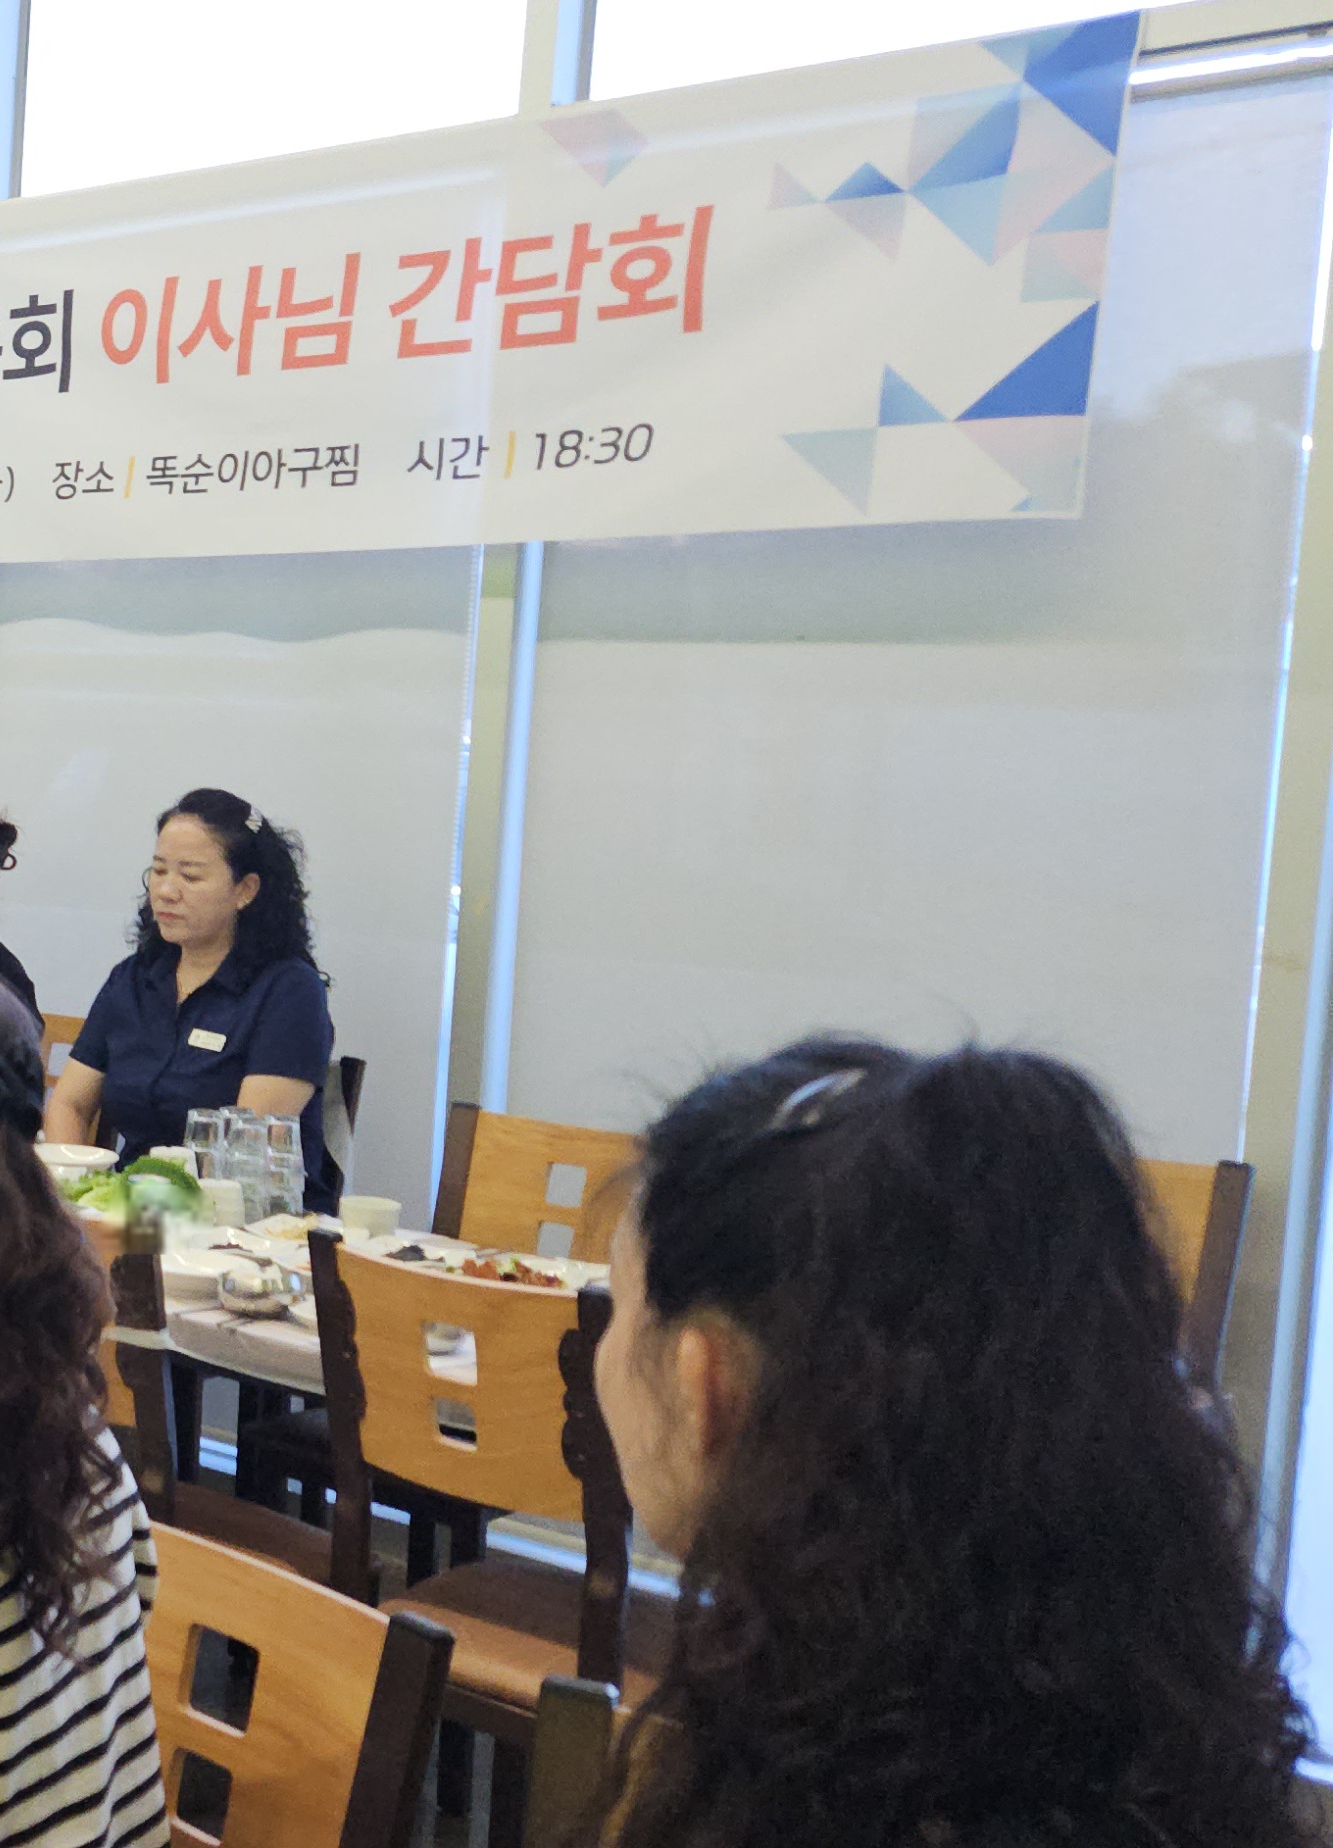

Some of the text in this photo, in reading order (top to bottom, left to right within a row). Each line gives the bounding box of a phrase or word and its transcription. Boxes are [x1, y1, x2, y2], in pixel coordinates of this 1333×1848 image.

[100, 251, 362, 385] 이사님
[388, 204, 715, 360] 간담회
[51, 443, 361, 501] 장소 똑순이아구찜
[406, 422, 655, 481] 시간 18:30
